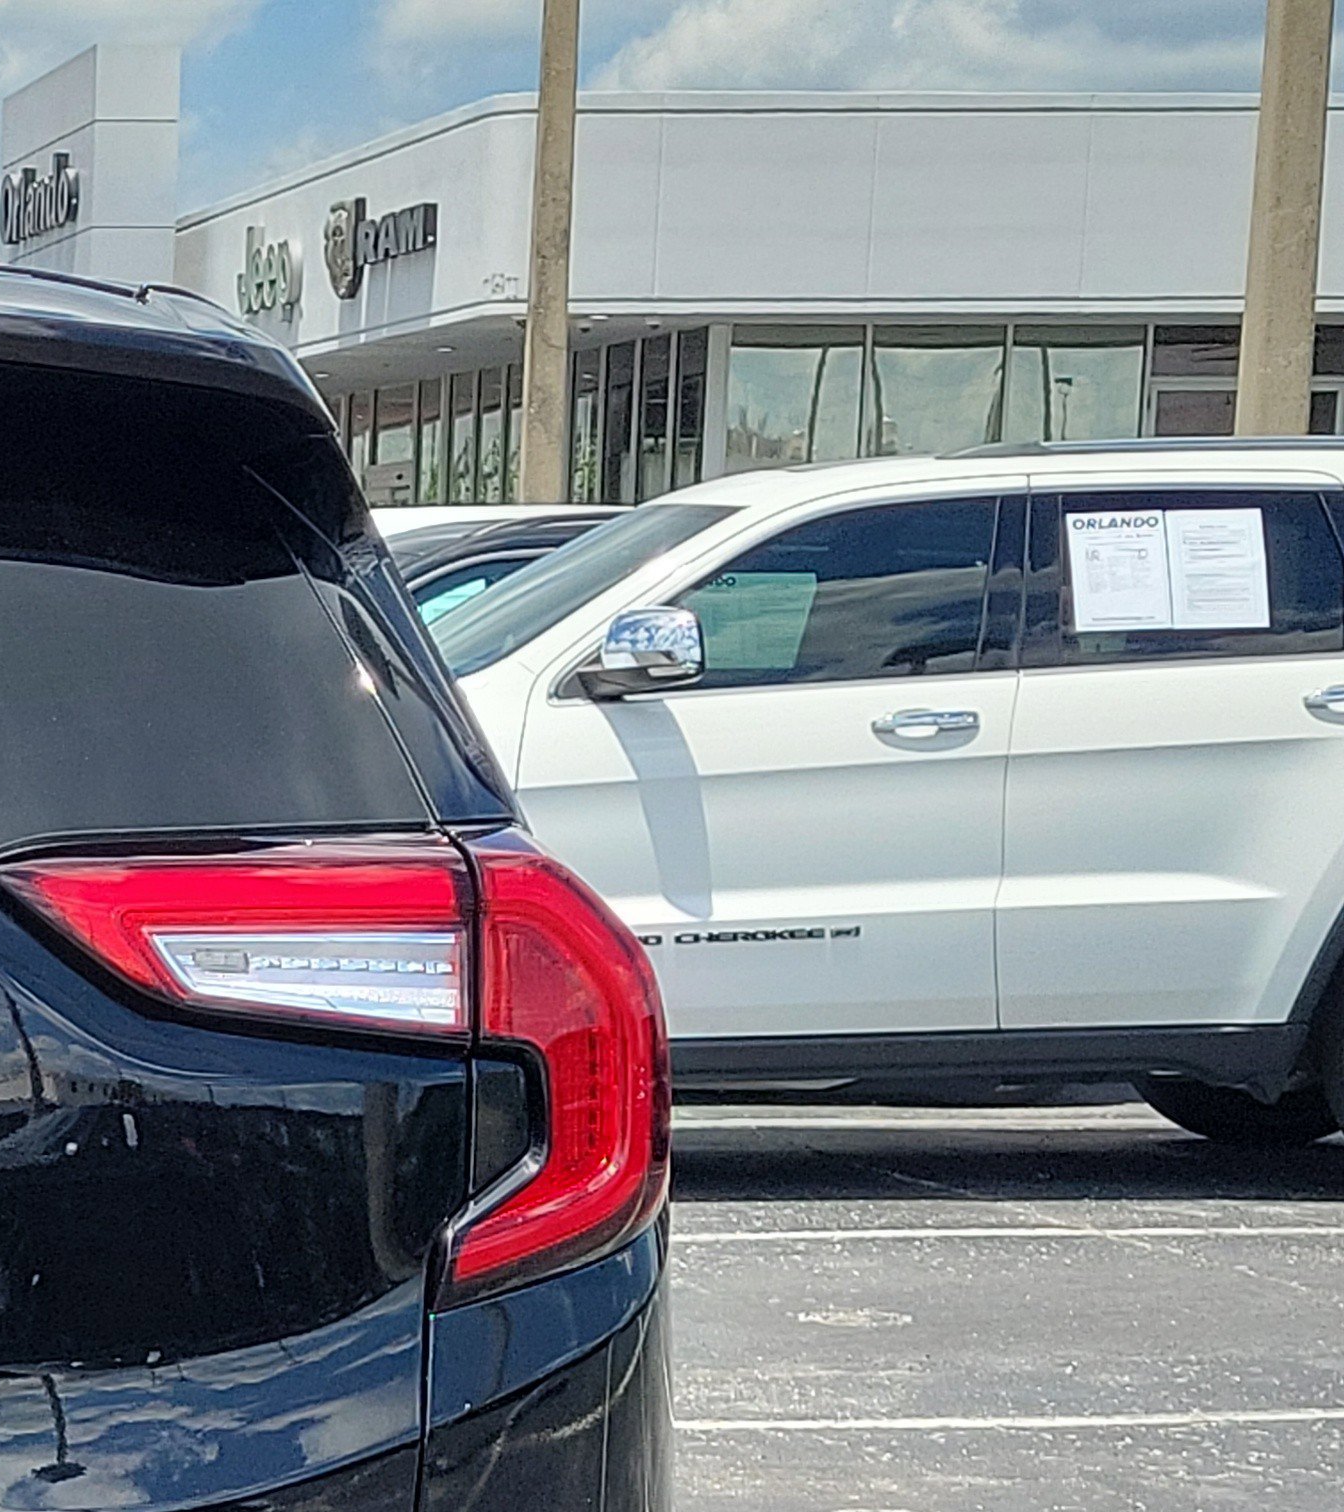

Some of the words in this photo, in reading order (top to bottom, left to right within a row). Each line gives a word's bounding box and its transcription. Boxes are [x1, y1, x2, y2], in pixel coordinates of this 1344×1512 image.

[0, 152, 80, 245] Orlando
[356, 203, 438, 266] RAM
[237, 226, 302, 324] Jeep
[1072, 516, 1160, 530] ORLANDO
[674, 928, 826, 945] CHEROKEE
